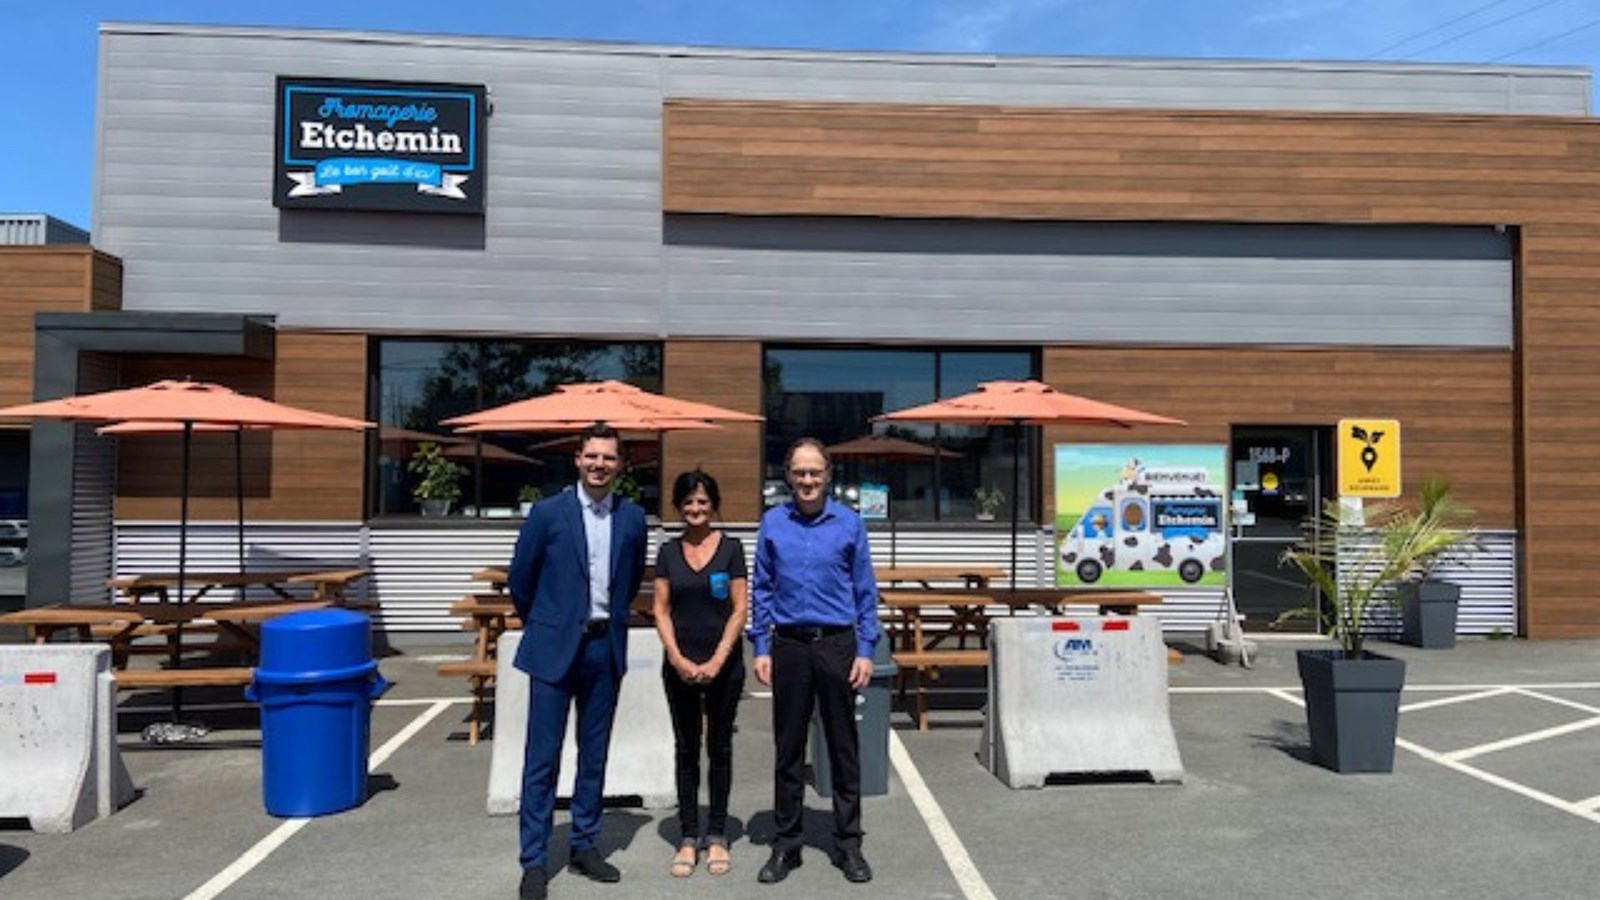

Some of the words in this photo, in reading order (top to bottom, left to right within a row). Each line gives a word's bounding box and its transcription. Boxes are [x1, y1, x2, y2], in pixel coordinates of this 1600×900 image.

[318, 97, 438, 127] Fromagerie
[300, 121, 463, 154] Etchemin
[344, 164, 368, 176] bon
[1157, 513, 1216, 526] Etchemin
